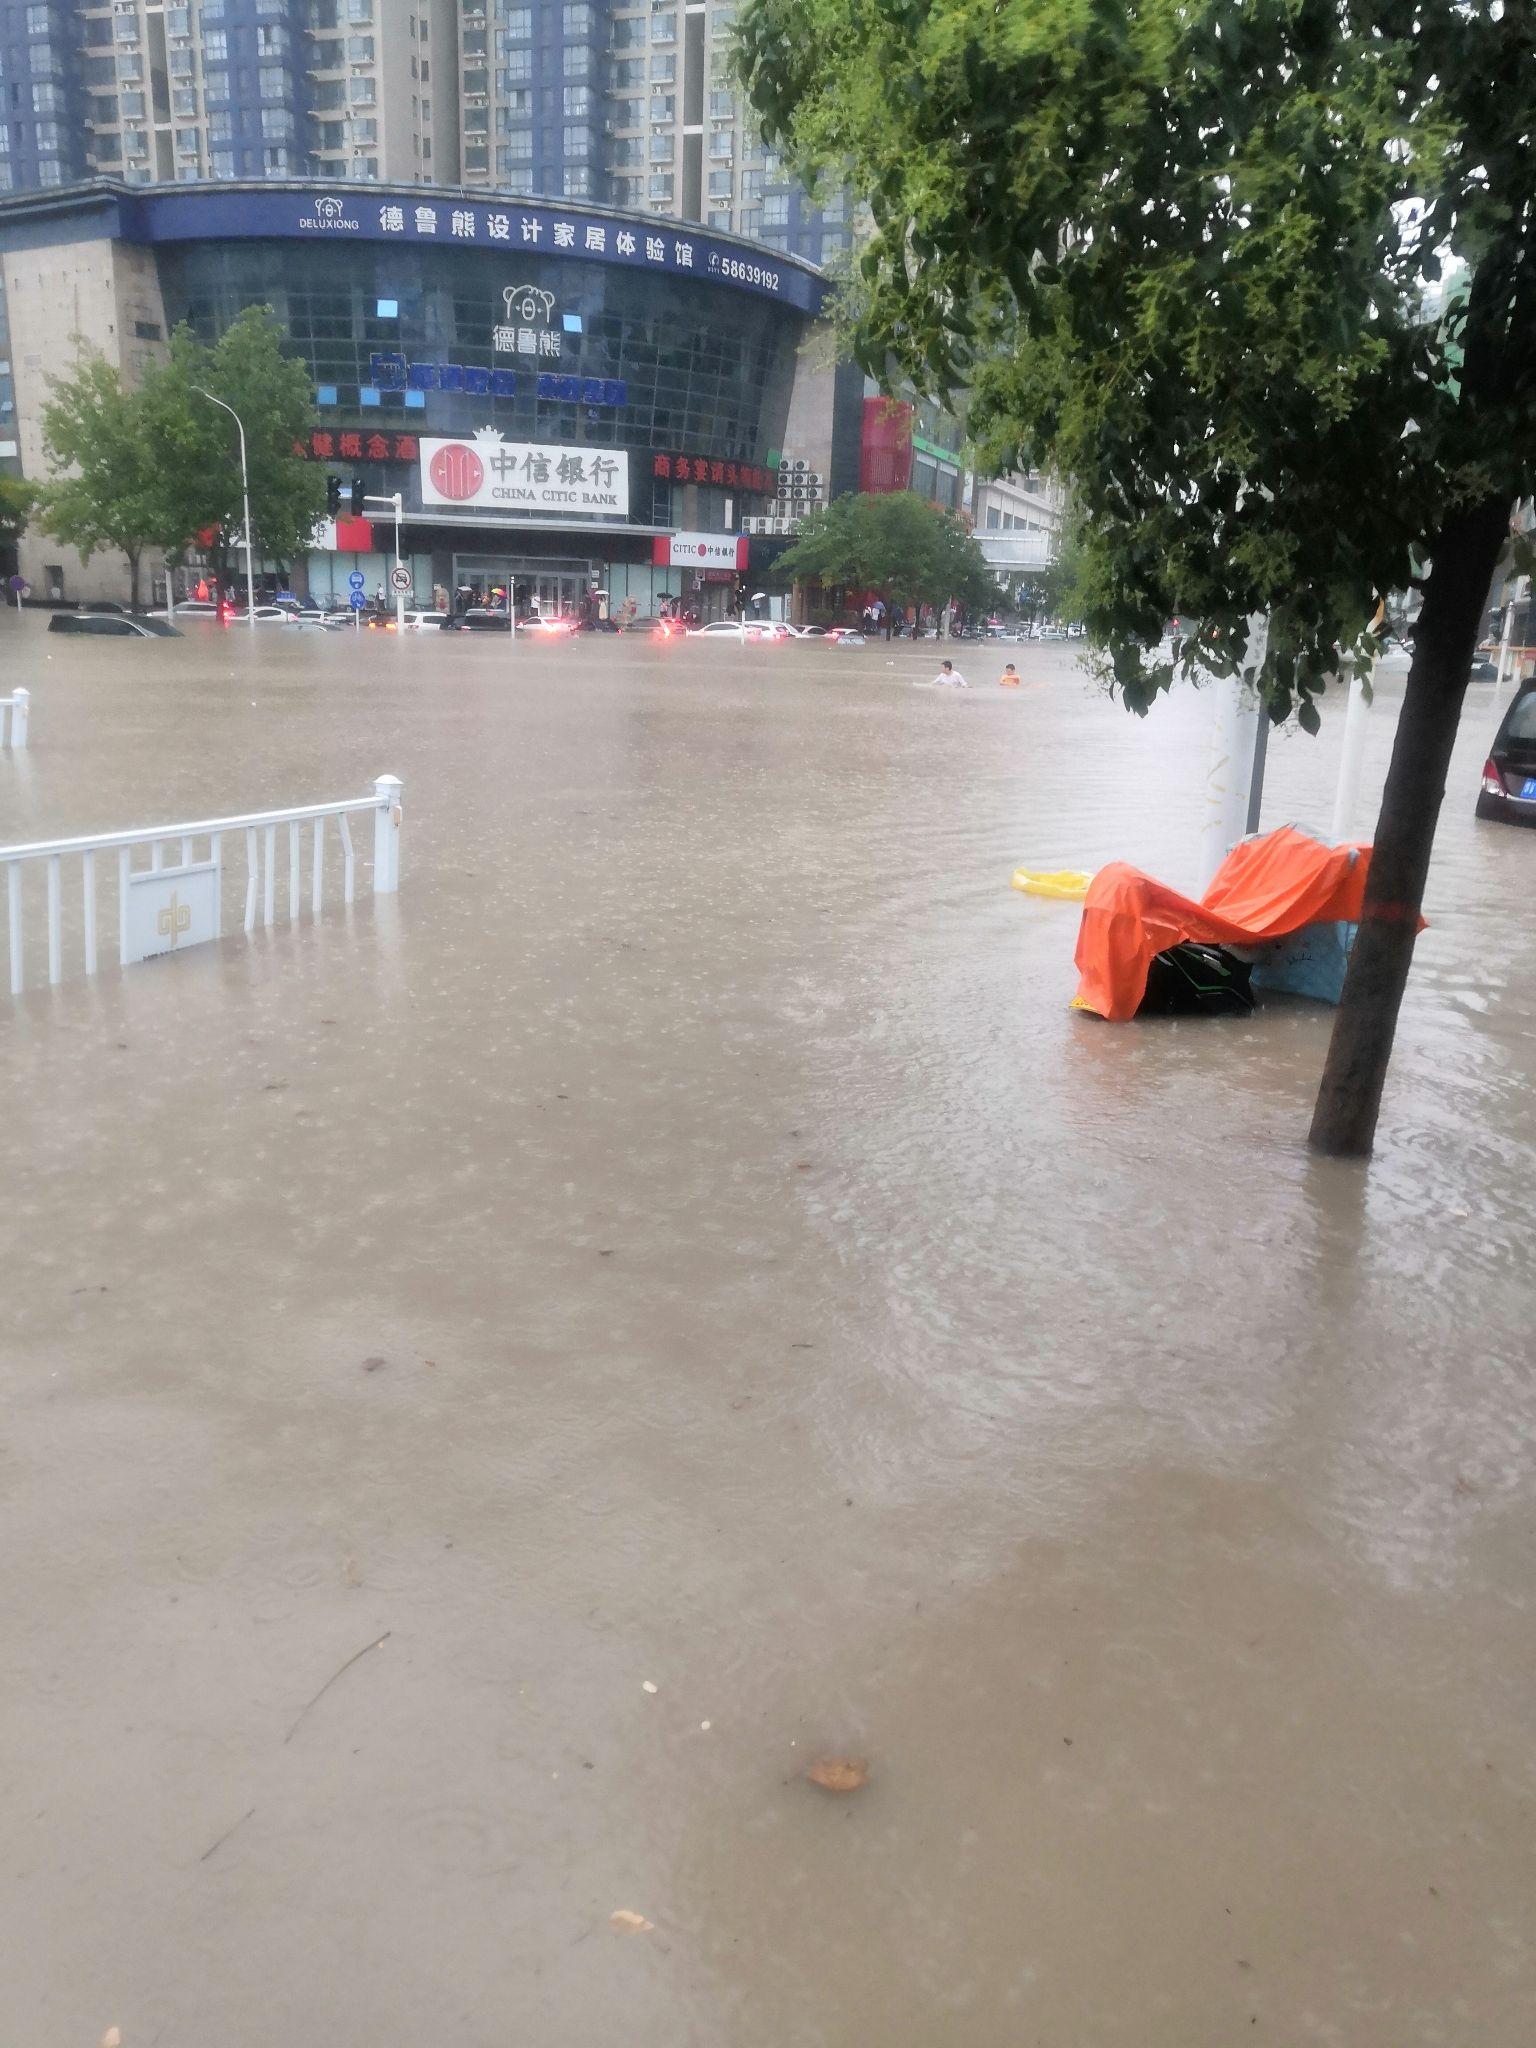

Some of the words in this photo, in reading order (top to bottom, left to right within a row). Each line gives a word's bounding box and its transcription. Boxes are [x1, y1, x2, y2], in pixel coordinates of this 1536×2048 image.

[299, 219, 359, 230] DELUXIONG
[379, 205, 693, 268] 德鲁熊设计家居体验馆
[721, 257, 779, 291] 58639192
[492, 324, 561, 357] 德鲁熊
[489, 448, 620, 489] 中信银行
[491, 487, 536, 501] CHINA
[542, 489, 577, 502] CITIC
[582, 493, 618, 506] BANK
[673, 543, 697, 554] CITIC
[708, 545, 735, 557] 中信银行
